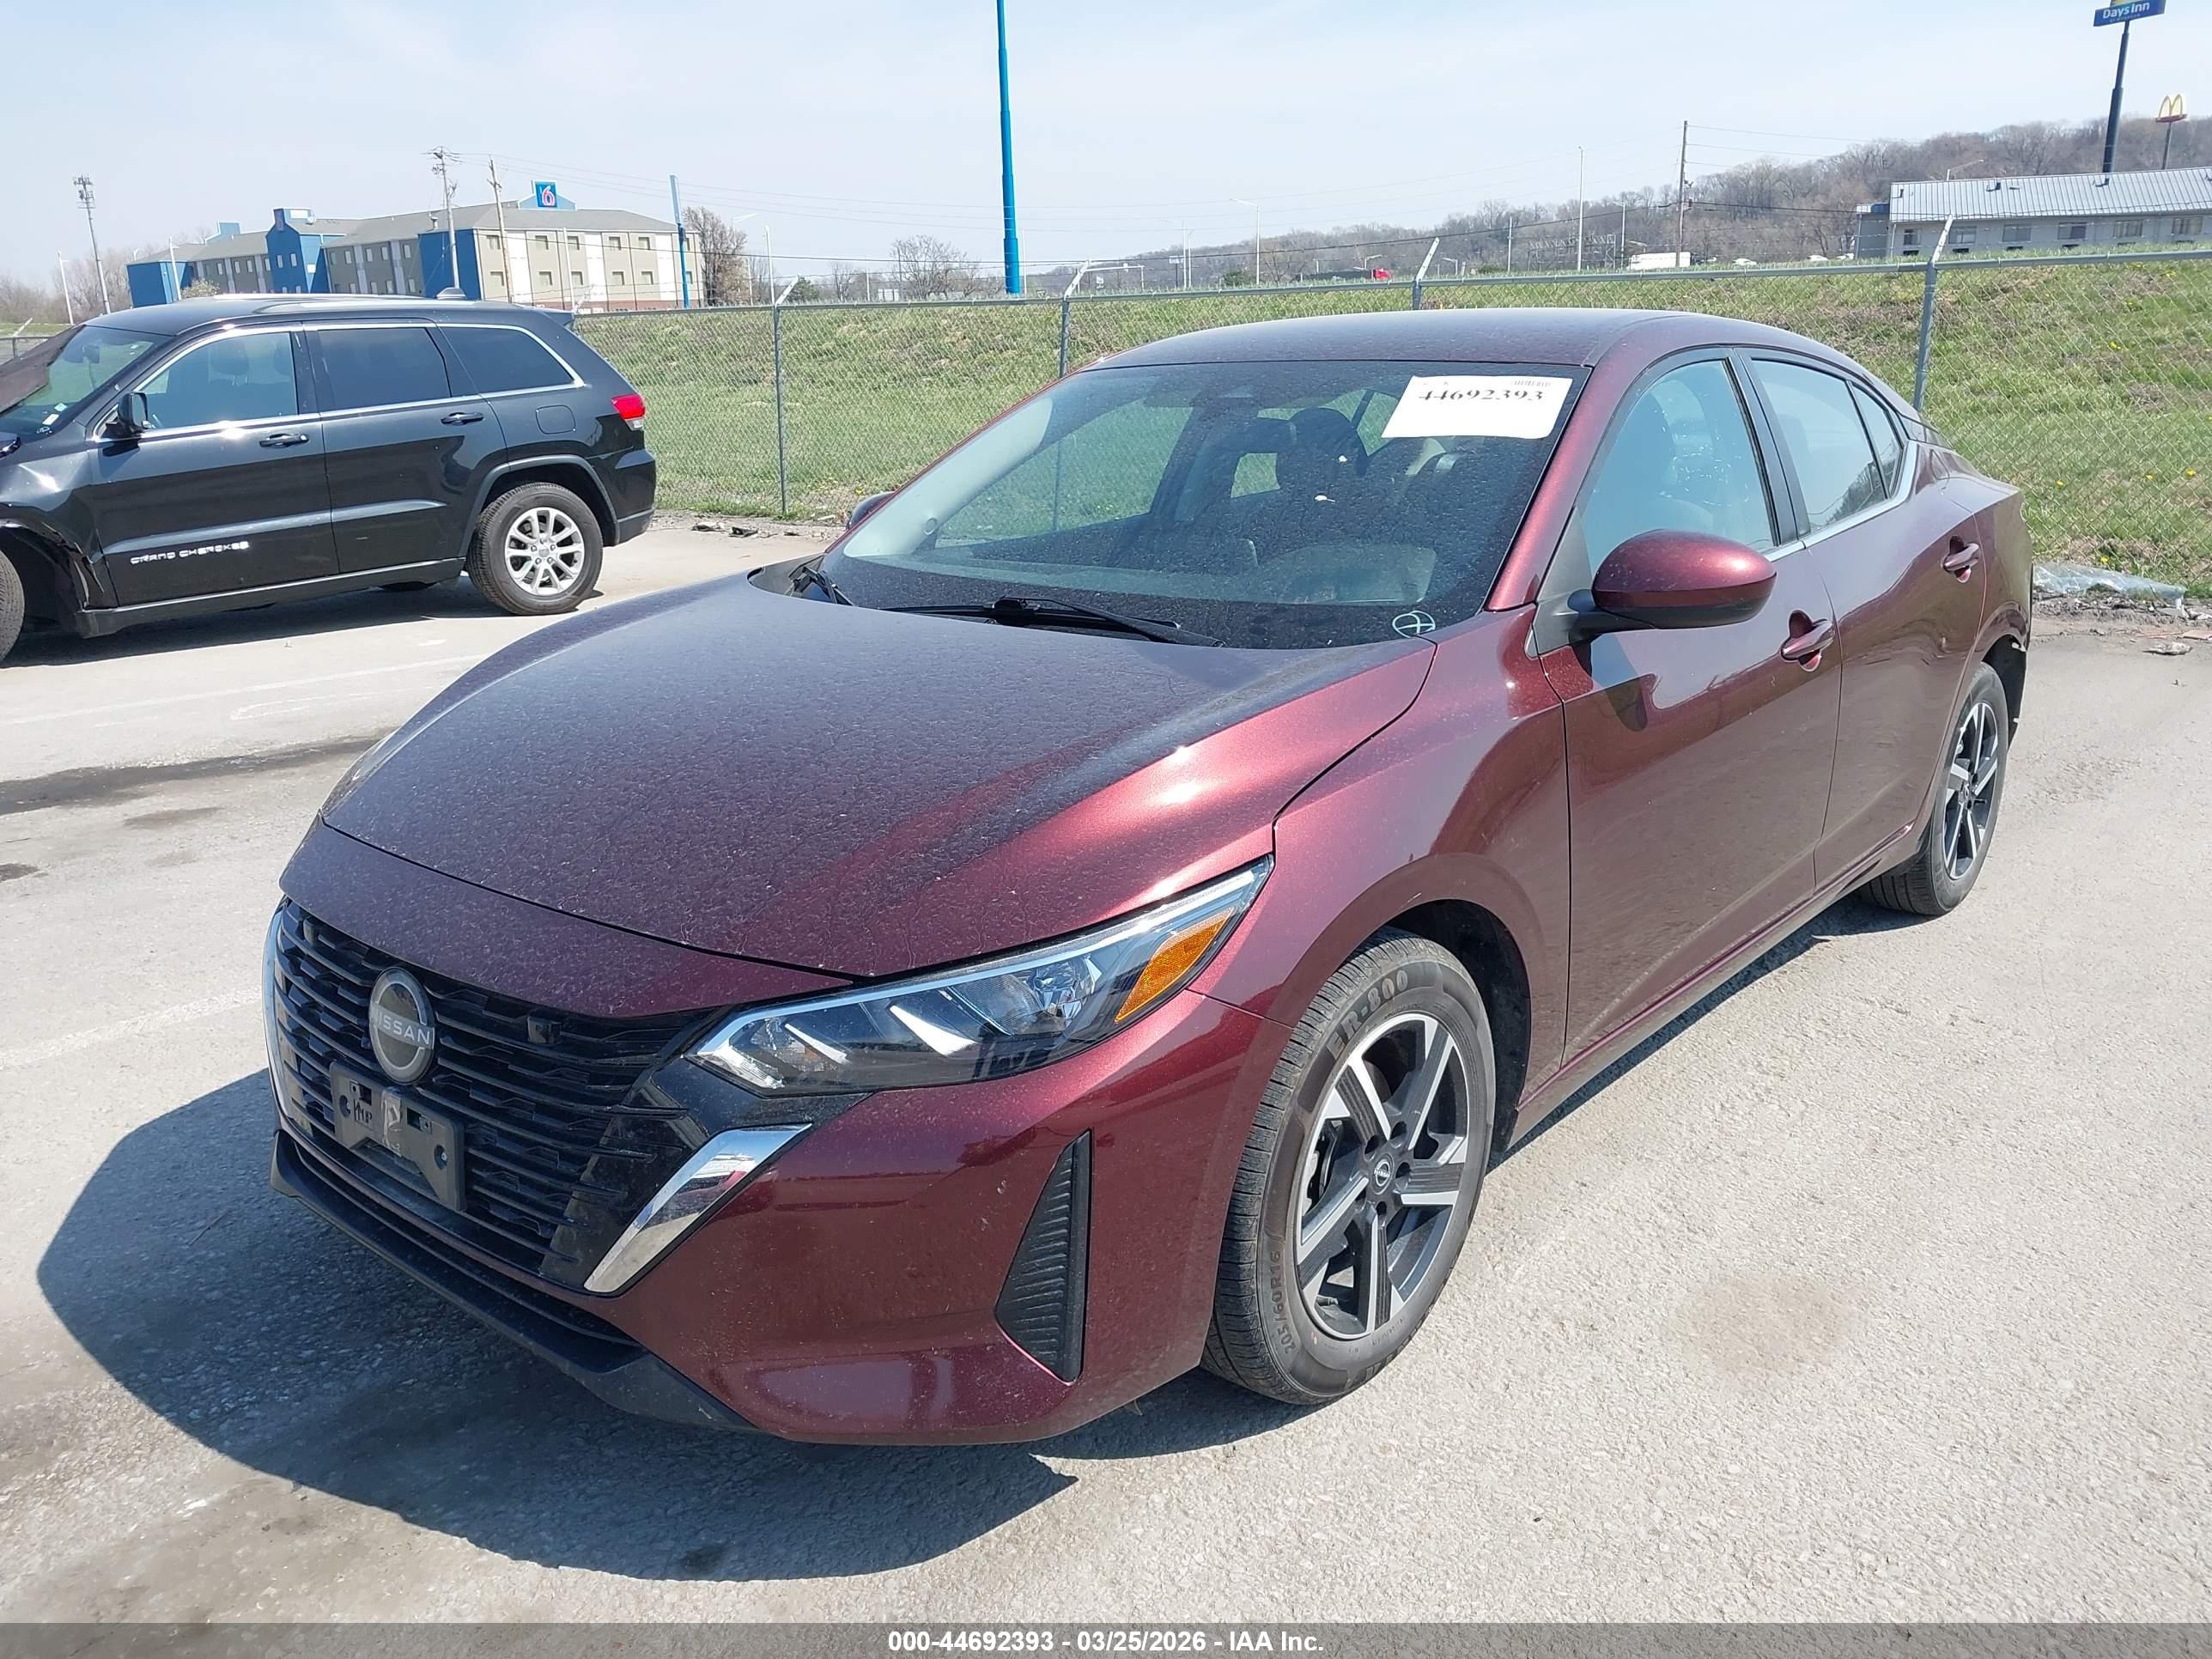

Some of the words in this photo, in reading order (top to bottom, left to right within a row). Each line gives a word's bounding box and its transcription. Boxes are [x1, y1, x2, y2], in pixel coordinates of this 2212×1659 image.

[2102, 5, 2130, 19] Days
[2130, 2, 2150, 14] Inn
[542, 185, 556, 206] 6
[1419, 389, 1545, 401] 44692393
[1270, 1250, 1297, 1354] 205/60R16
